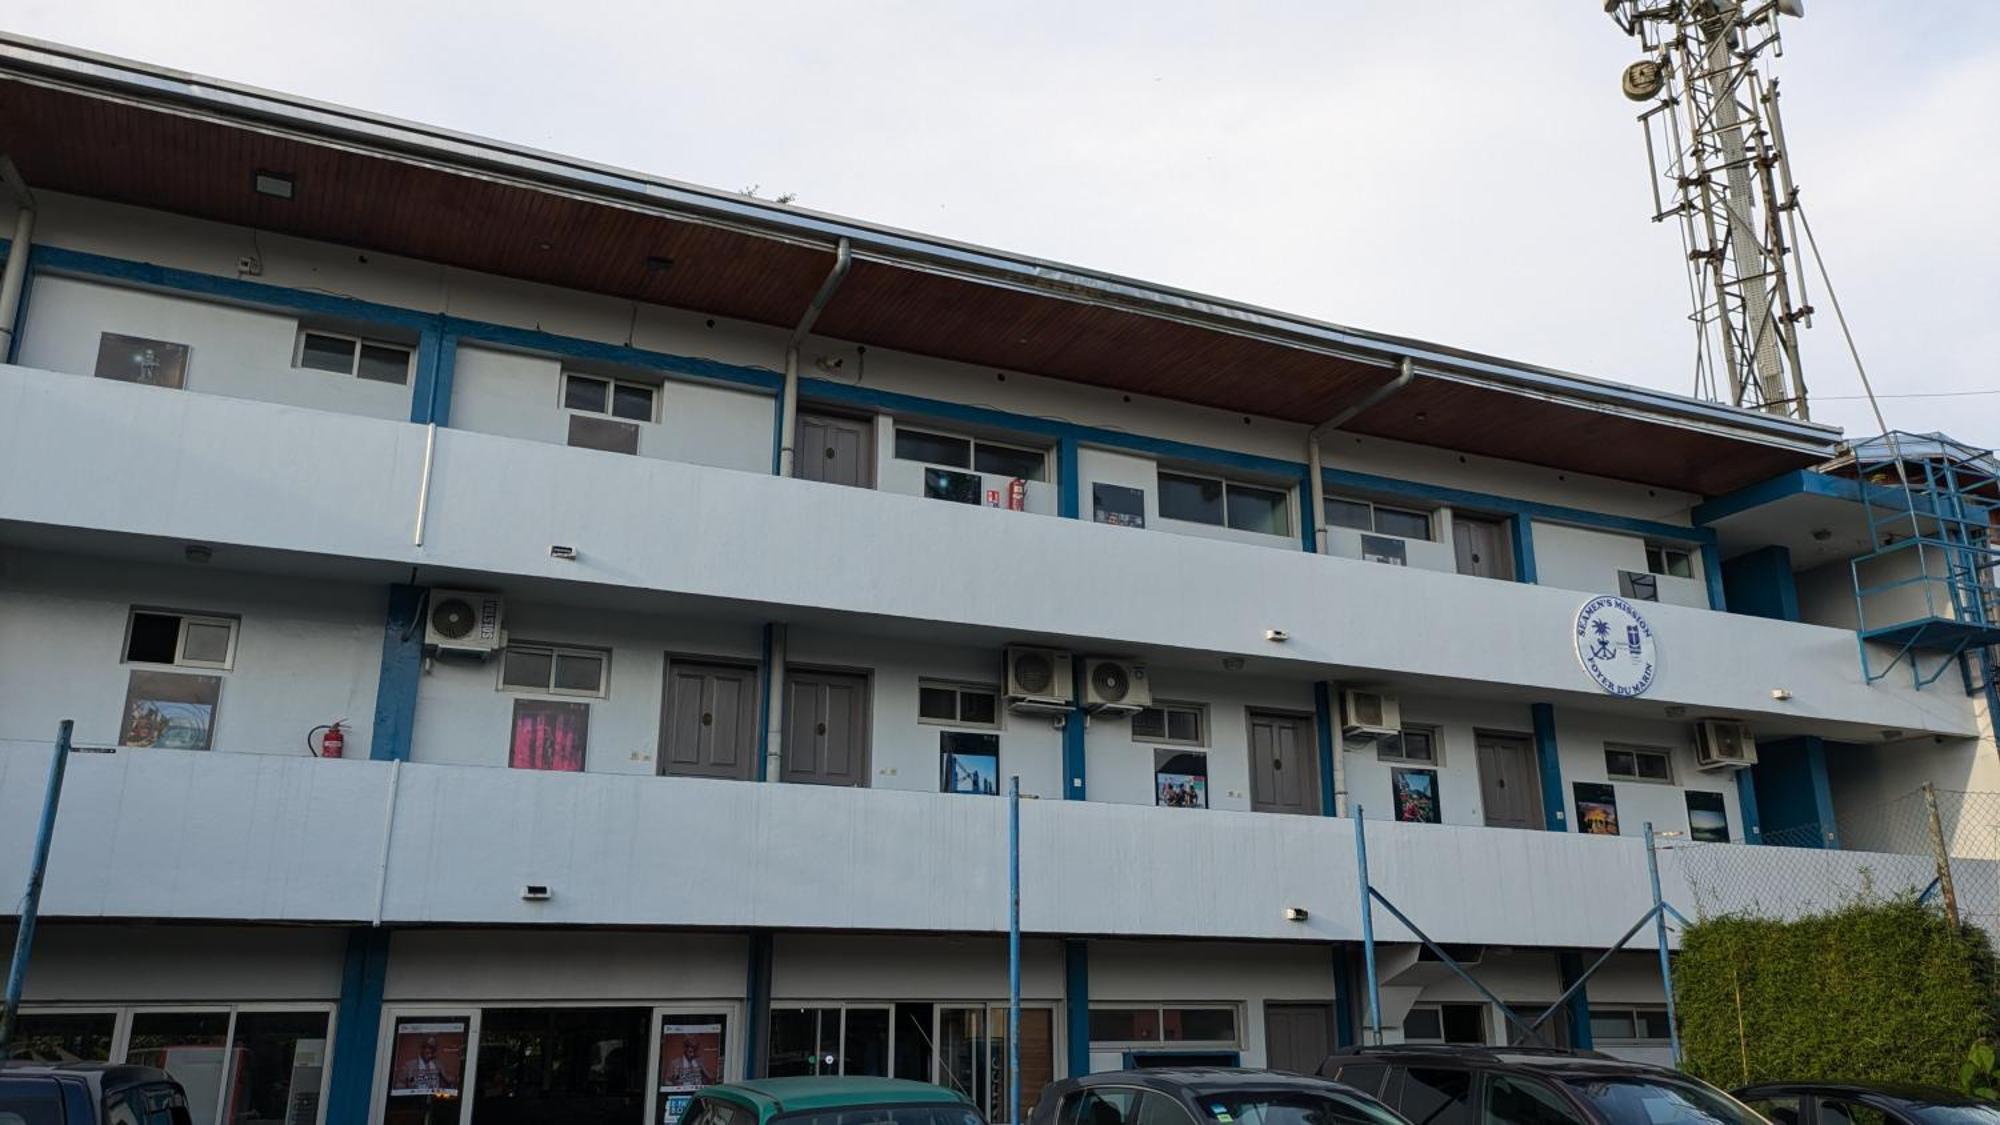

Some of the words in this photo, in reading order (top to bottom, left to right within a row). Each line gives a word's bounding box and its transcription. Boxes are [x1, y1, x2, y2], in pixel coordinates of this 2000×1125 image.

[1578, 599, 1613, 637] SEAMEN'S
[1615, 600, 1653, 637] MISSION
[1587, 657, 1614, 691] FOYER
[1617, 686, 1631, 695] DU
[1632, 662, 1653, 694] MARIN
